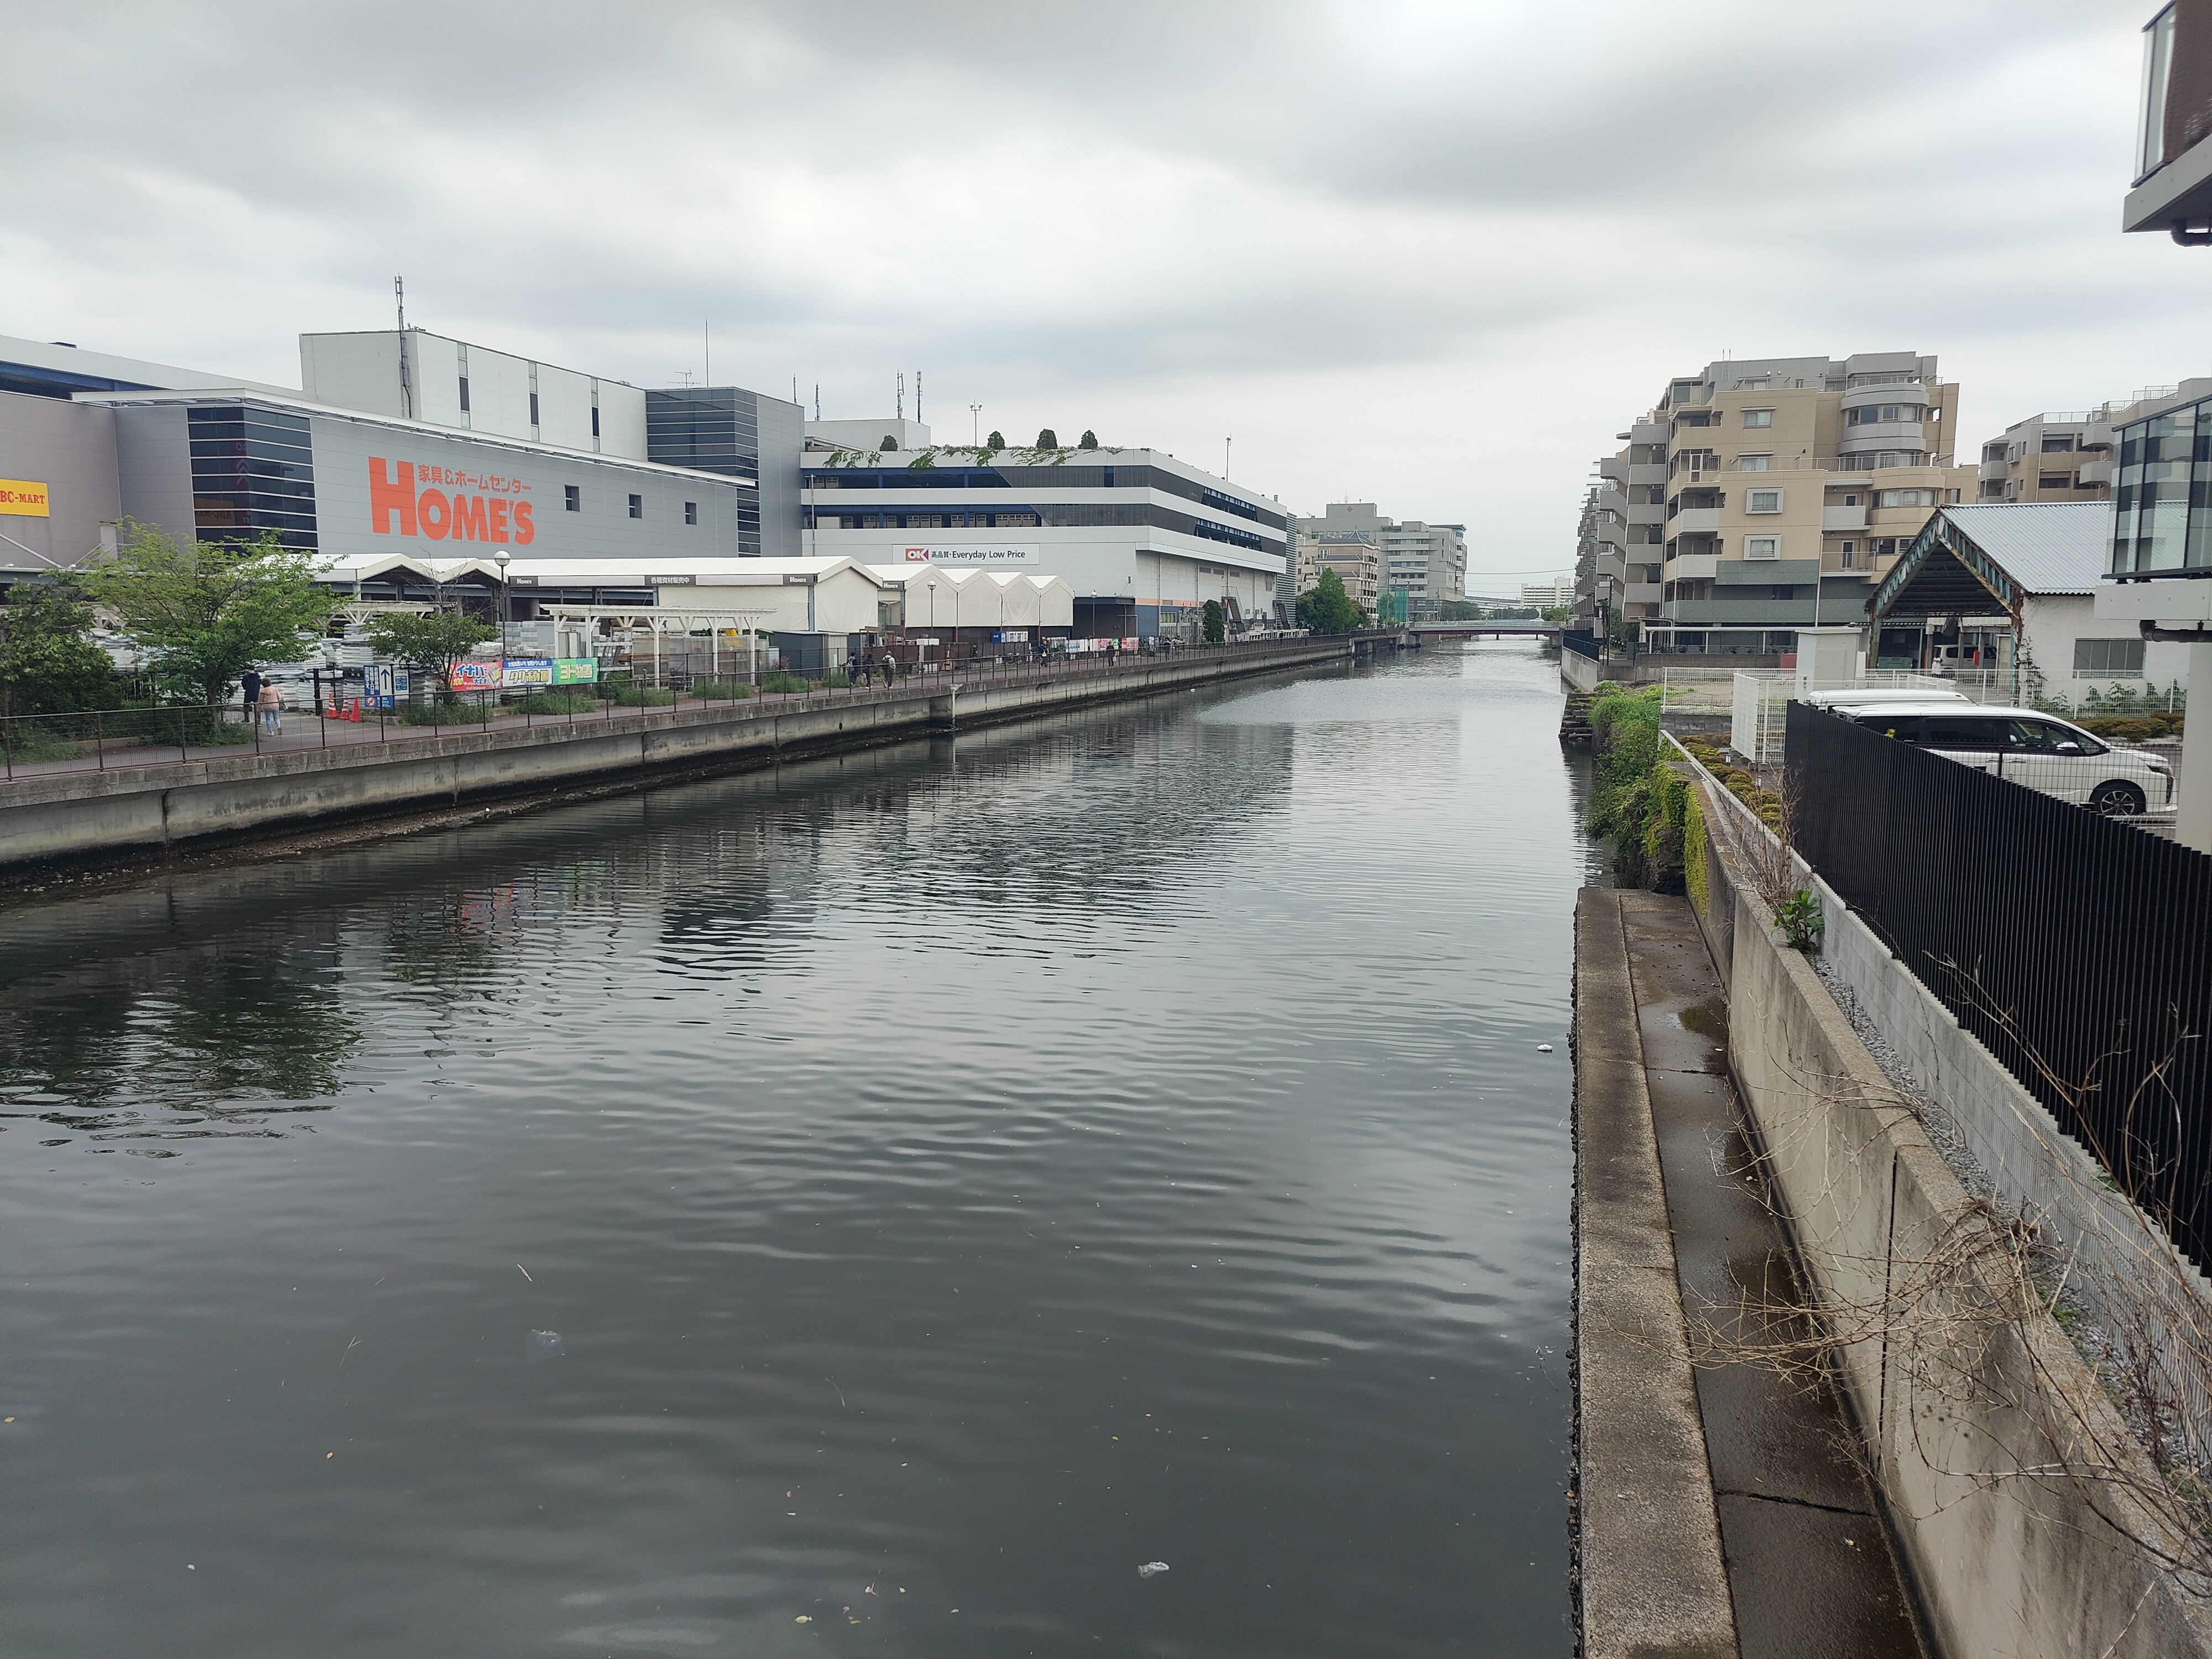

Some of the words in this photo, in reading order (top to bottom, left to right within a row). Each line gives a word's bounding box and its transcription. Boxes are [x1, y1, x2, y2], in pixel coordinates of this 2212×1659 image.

[368, 456, 535, 545] HOME'S
[907, 548, 929, 561] OK
[456, 664, 487, 678] イナバ
[560, 664, 593, 680] ヨド物置
